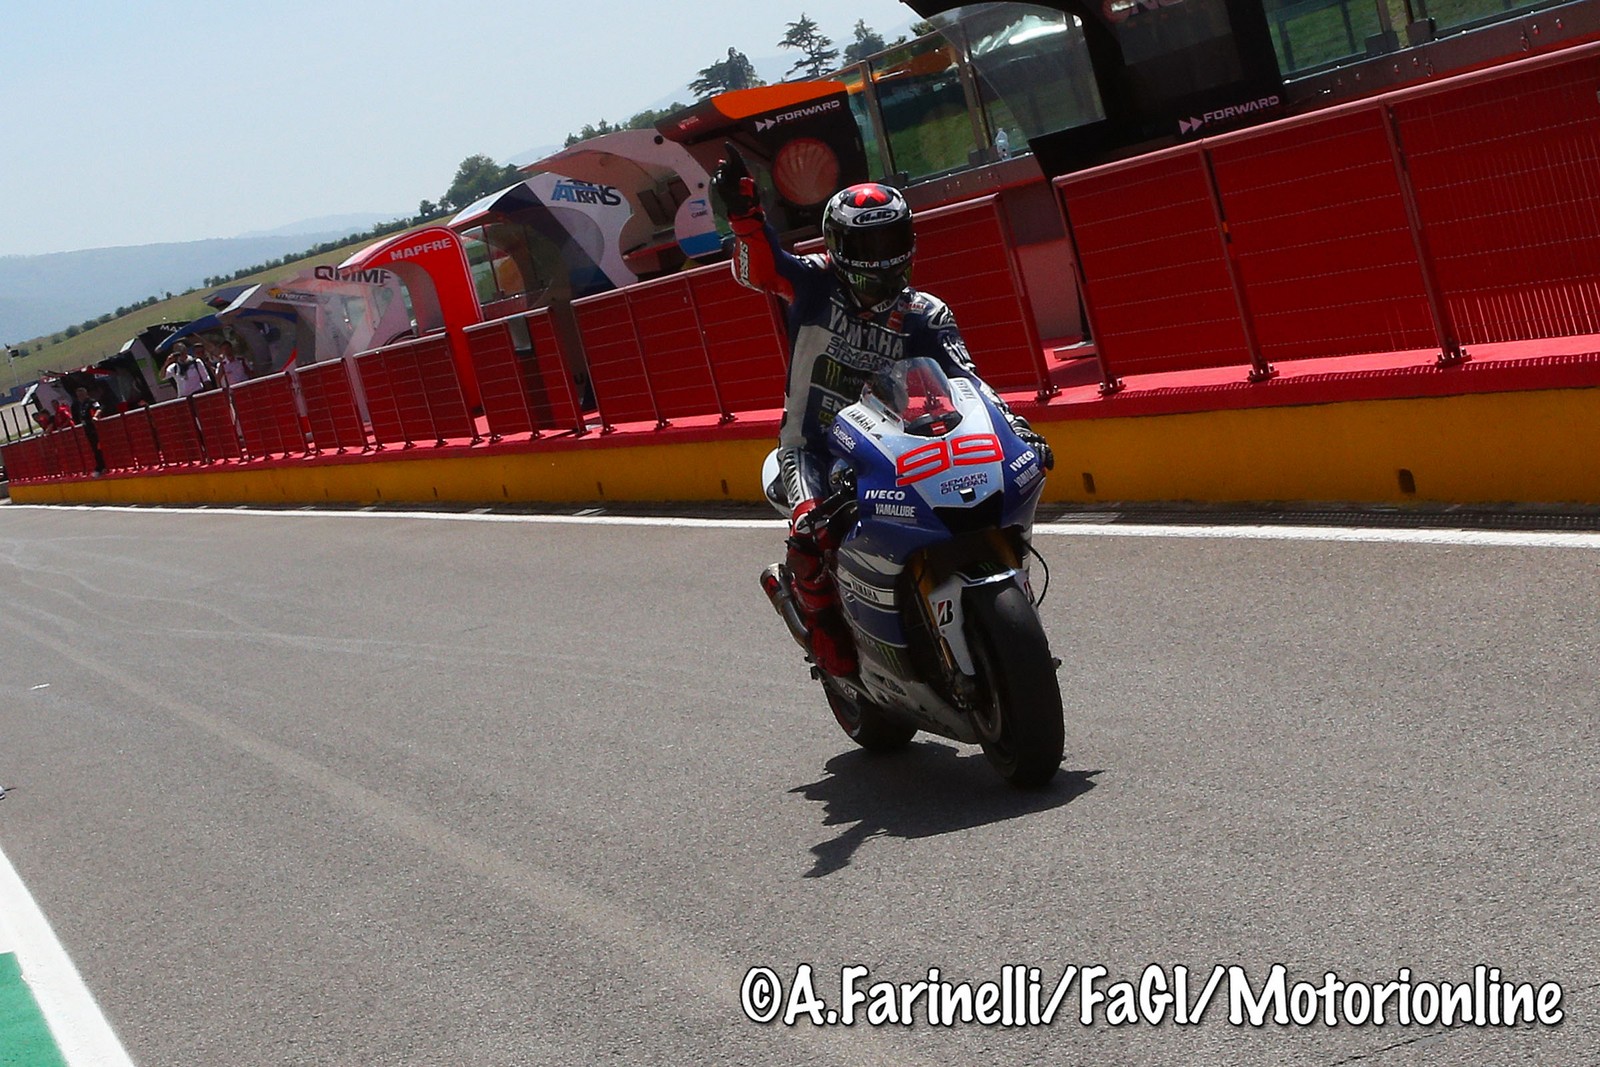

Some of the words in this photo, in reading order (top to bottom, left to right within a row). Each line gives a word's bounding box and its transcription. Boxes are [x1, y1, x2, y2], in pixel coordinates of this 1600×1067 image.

[775, 100, 841, 123] FORWARD
[1202, 95, 1280, 123] FORWARD
[859, 210, 892, 222] HJC
[390, 238, 452, 260] MAPFRE
[314, 265, 392, 285] QMMF
[829, 305, 903, 359] YAMAHA
[847, 408, 877, 433] YAMAHA
[896, 434, 1004, 486] 99
[1009, 450, 1036, 472] IVECO
[940, 473, 987, 487] SEMAKIN
[941, 487, 953, 495] DI
[953, 479, 988, 492] DEPAN
[864, 489, 906, 501] IVECO
[875, 503, 916, 518] YAMALUBE
